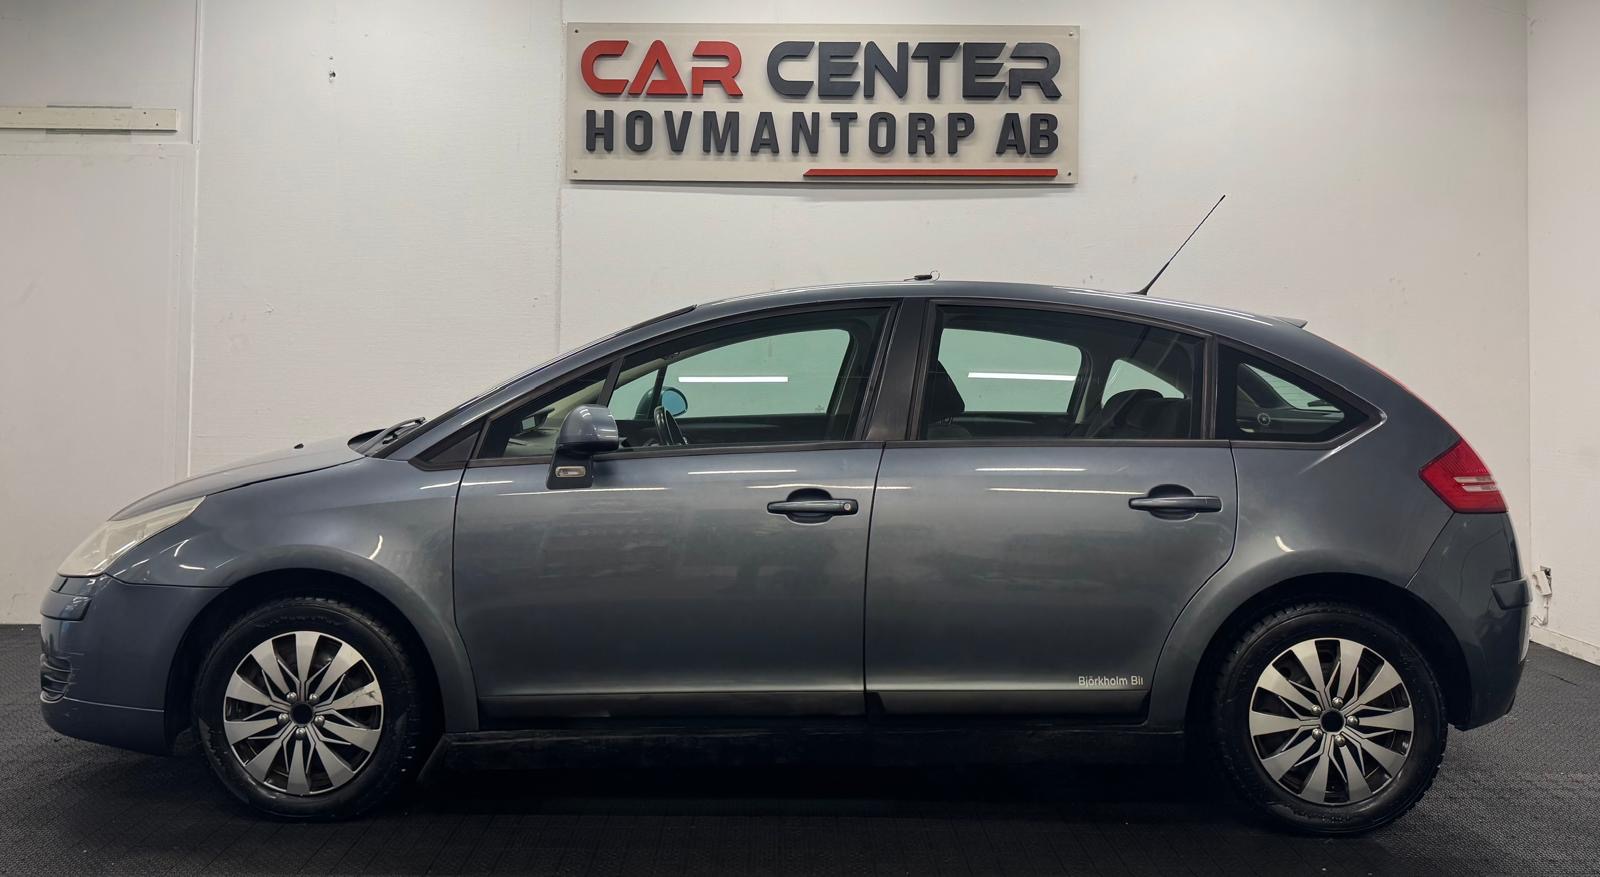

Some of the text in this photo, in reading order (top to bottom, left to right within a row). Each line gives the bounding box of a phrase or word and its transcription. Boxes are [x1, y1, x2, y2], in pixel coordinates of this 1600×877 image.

[580, 39, 1062, 99] CAR CENTER
[585, 109, 1060, 155] HOVMANTORP AB
[1078, 675, 1128, 688] Björkholm
